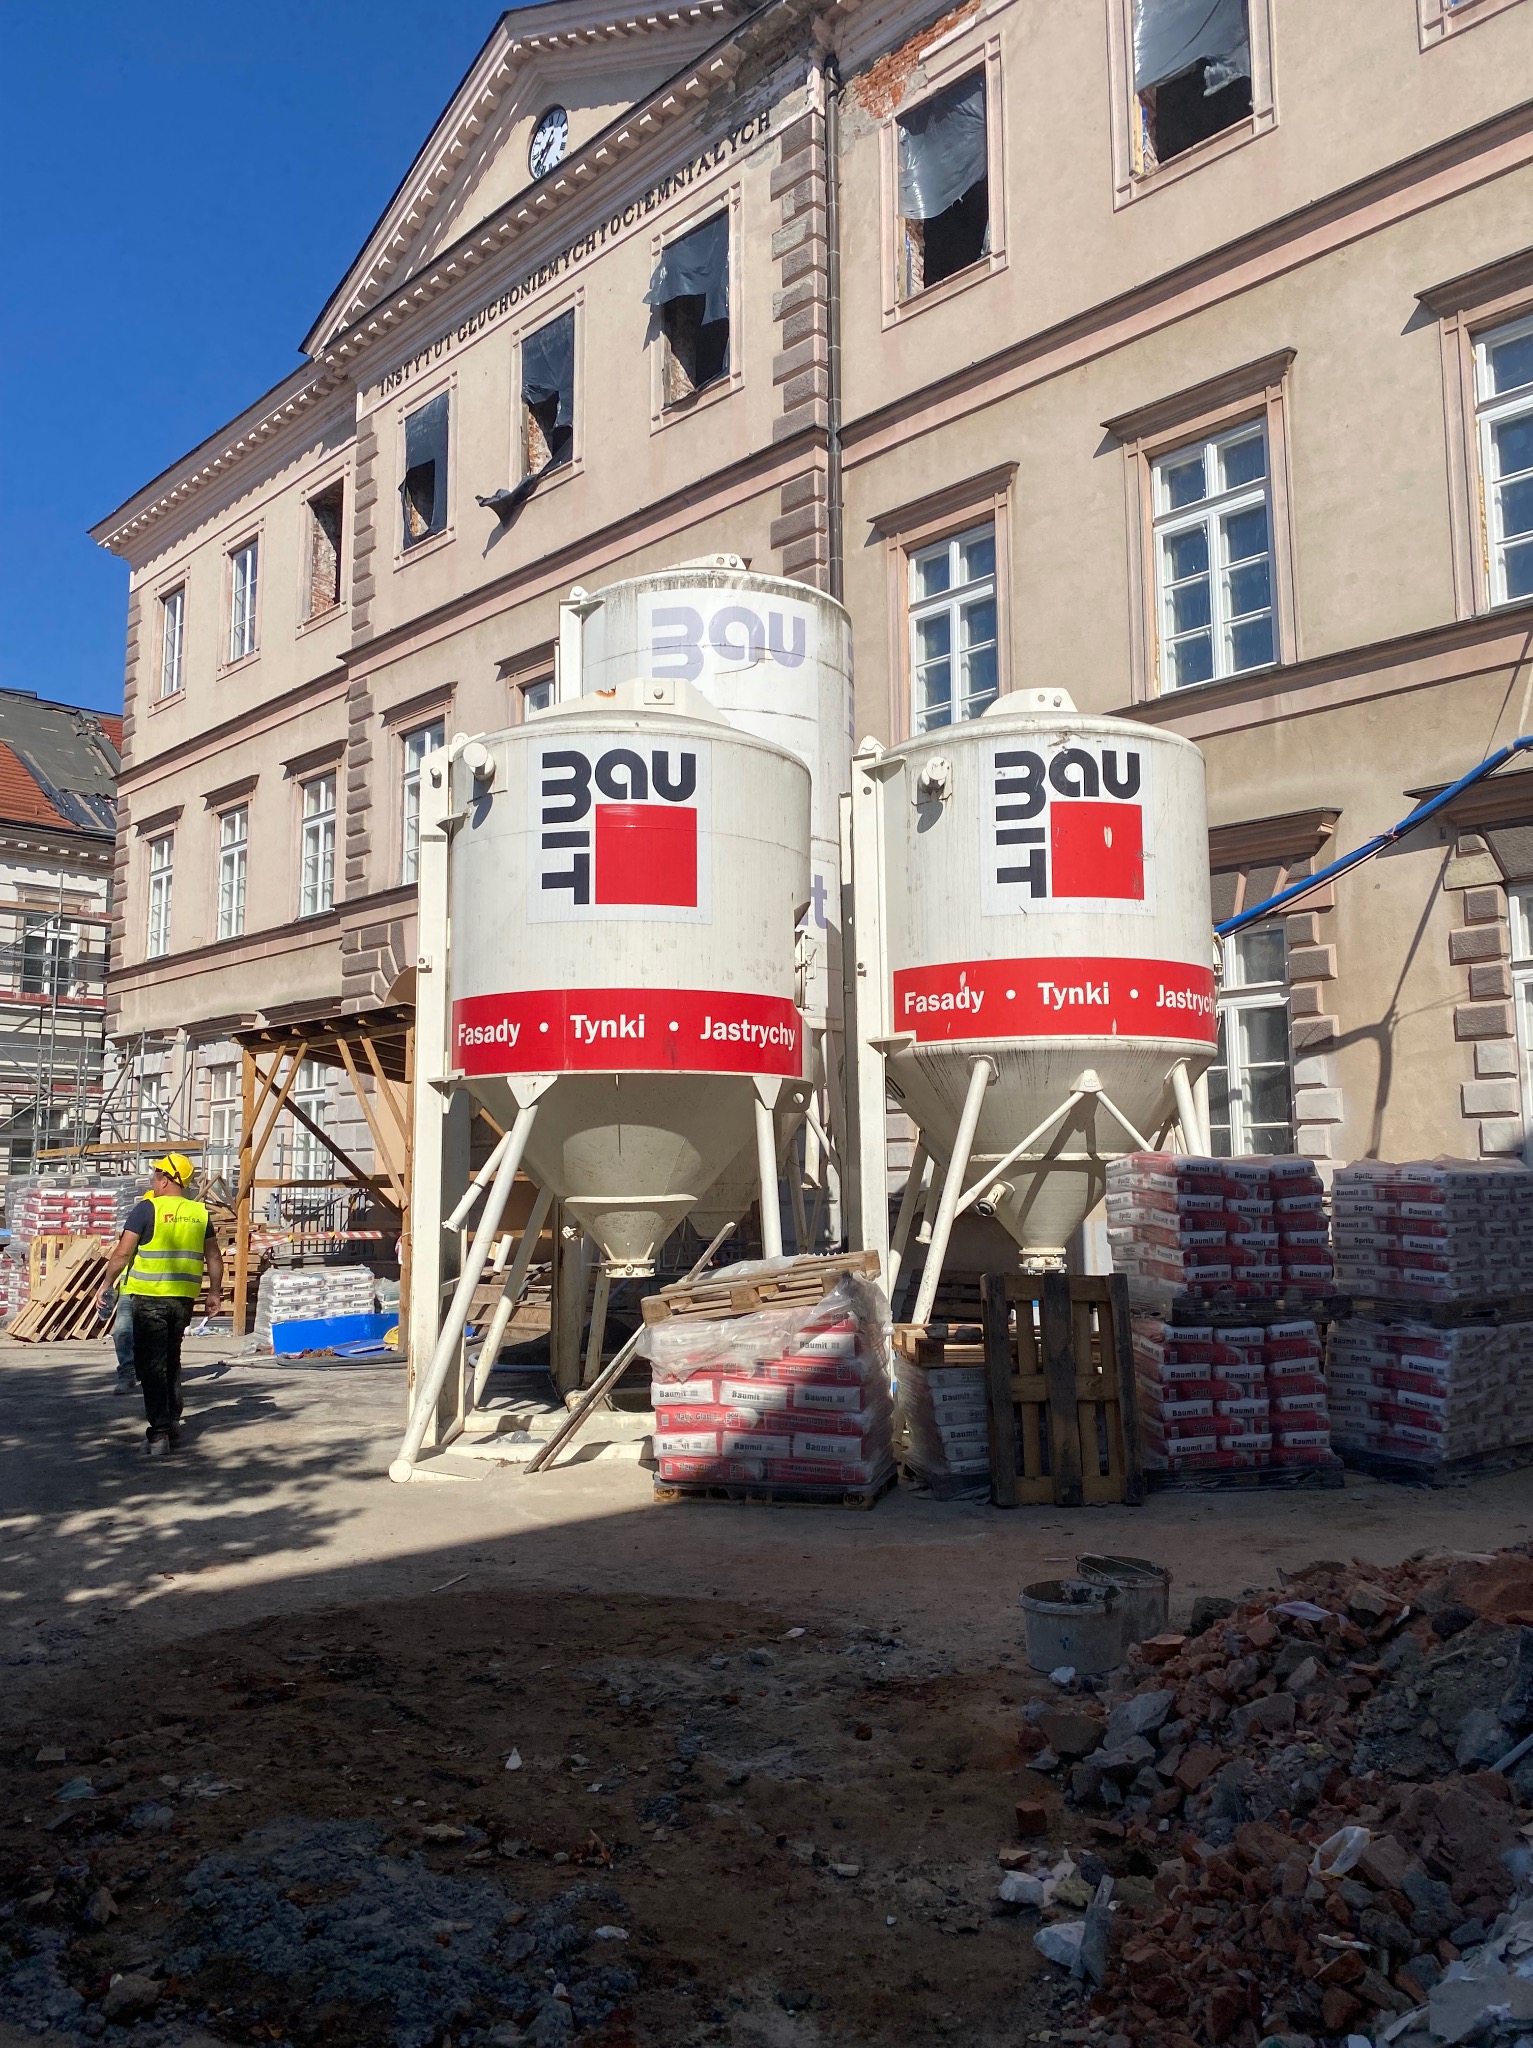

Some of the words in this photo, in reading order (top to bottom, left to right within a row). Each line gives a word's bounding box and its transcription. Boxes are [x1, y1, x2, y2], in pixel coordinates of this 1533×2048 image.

[380, 331, 454, 397] INSTYTUT
[905, 986, 985, 1014] Fasady
[1037, 982, 1110, 1010] Tynki
[458, 1018, 521, 1047] Fasady
[570, 1013, 645, 1044] Tynki
[700, 1016, 796, 1051] Jastrychy
[1409, 1208, 1432, 1216] Baumit
[1410, 1241, 1433, 1249] Baumit
[1411, 1274, 1435, 1282] Baumit
[800, 1341, 828, 1349] Baumit
[1409, 1362, 1434, 1372] Baumit
[660, 1390, 686, 1398] Baumit
[732, 1390, 760, 1400] Baumit
[804, 1393, 833, 1403] Baumit
[942, 1392, 969, 1401] Baumit
[1405, 1398, 1430, 1409] Baumit
[951, 1430, 978, 1438] Baumit
[1402, 1430, 1427, 1441] Baumit
[734, 1442, 762, 1451] Baumit
[805, 1442, 834, 1452] Baumit
